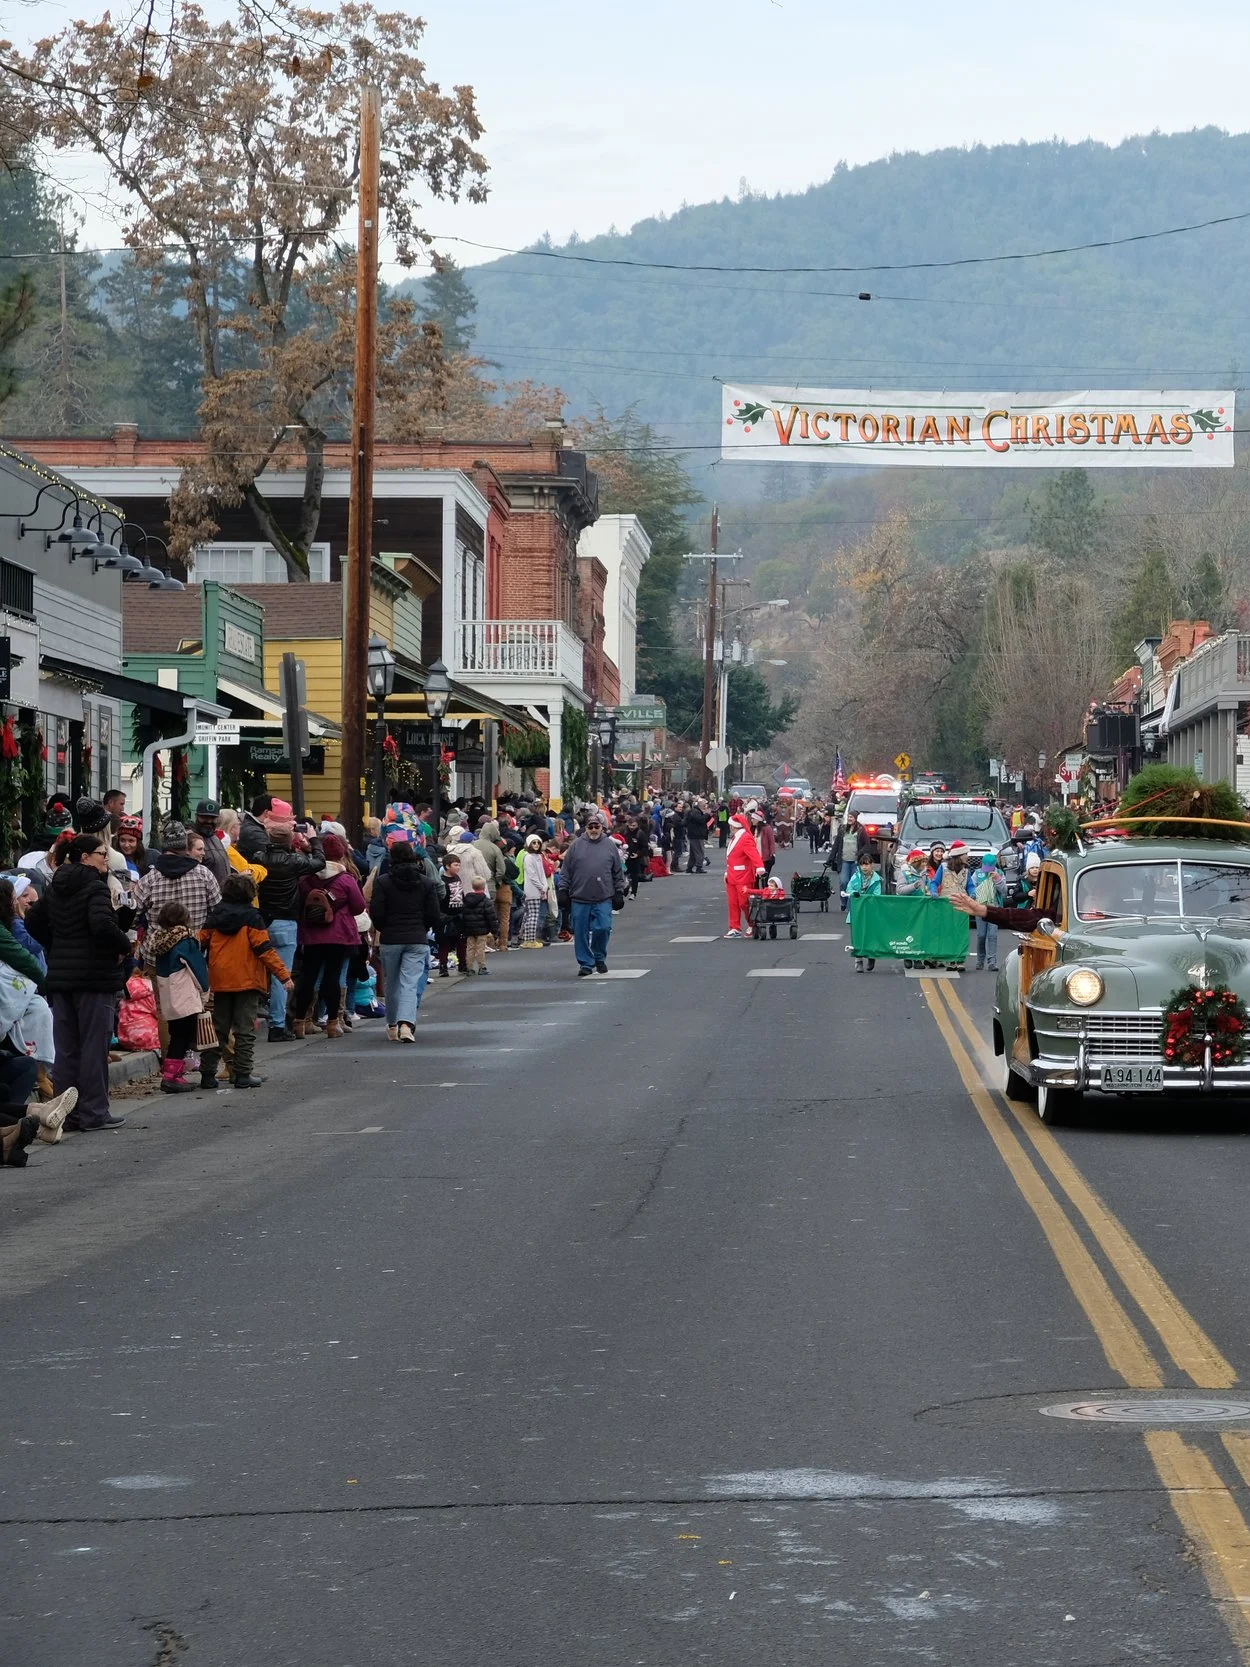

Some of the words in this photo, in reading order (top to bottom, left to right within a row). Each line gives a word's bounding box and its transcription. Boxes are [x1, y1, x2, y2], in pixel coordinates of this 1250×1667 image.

[772, 405, 971, 446] VICTORIAN
[982, 410, 1194, 452] CHRISTMAS
[250, 746, 283, 754] Ramsa
[1104, 1069, 1161, 1082] A-94-144
